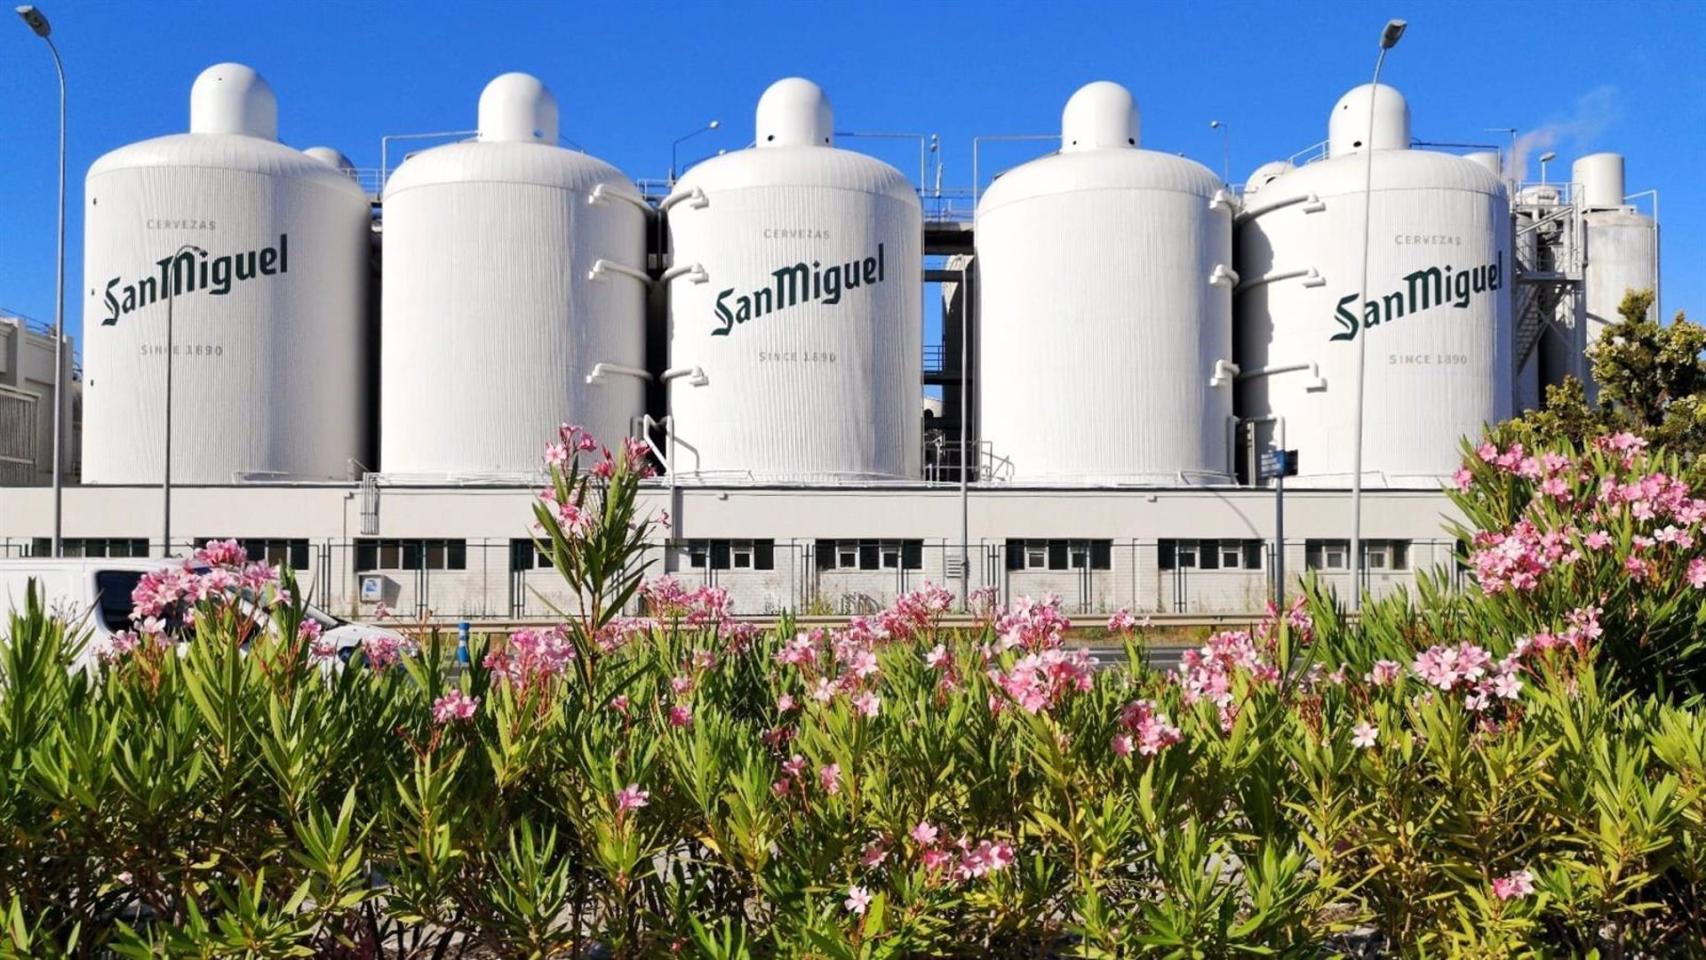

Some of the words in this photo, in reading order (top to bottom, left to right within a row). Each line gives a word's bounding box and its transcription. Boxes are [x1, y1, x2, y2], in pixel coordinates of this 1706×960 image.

[146, 219, 217, 231] CERVEZAS
[763, 228, 831, 240] CERVEZAS
[1394, 234, 1462, 246] CERVEZAS
[759, 351, 798, 362] SINCE
[1388, 354, 1431, 365] SINCE
